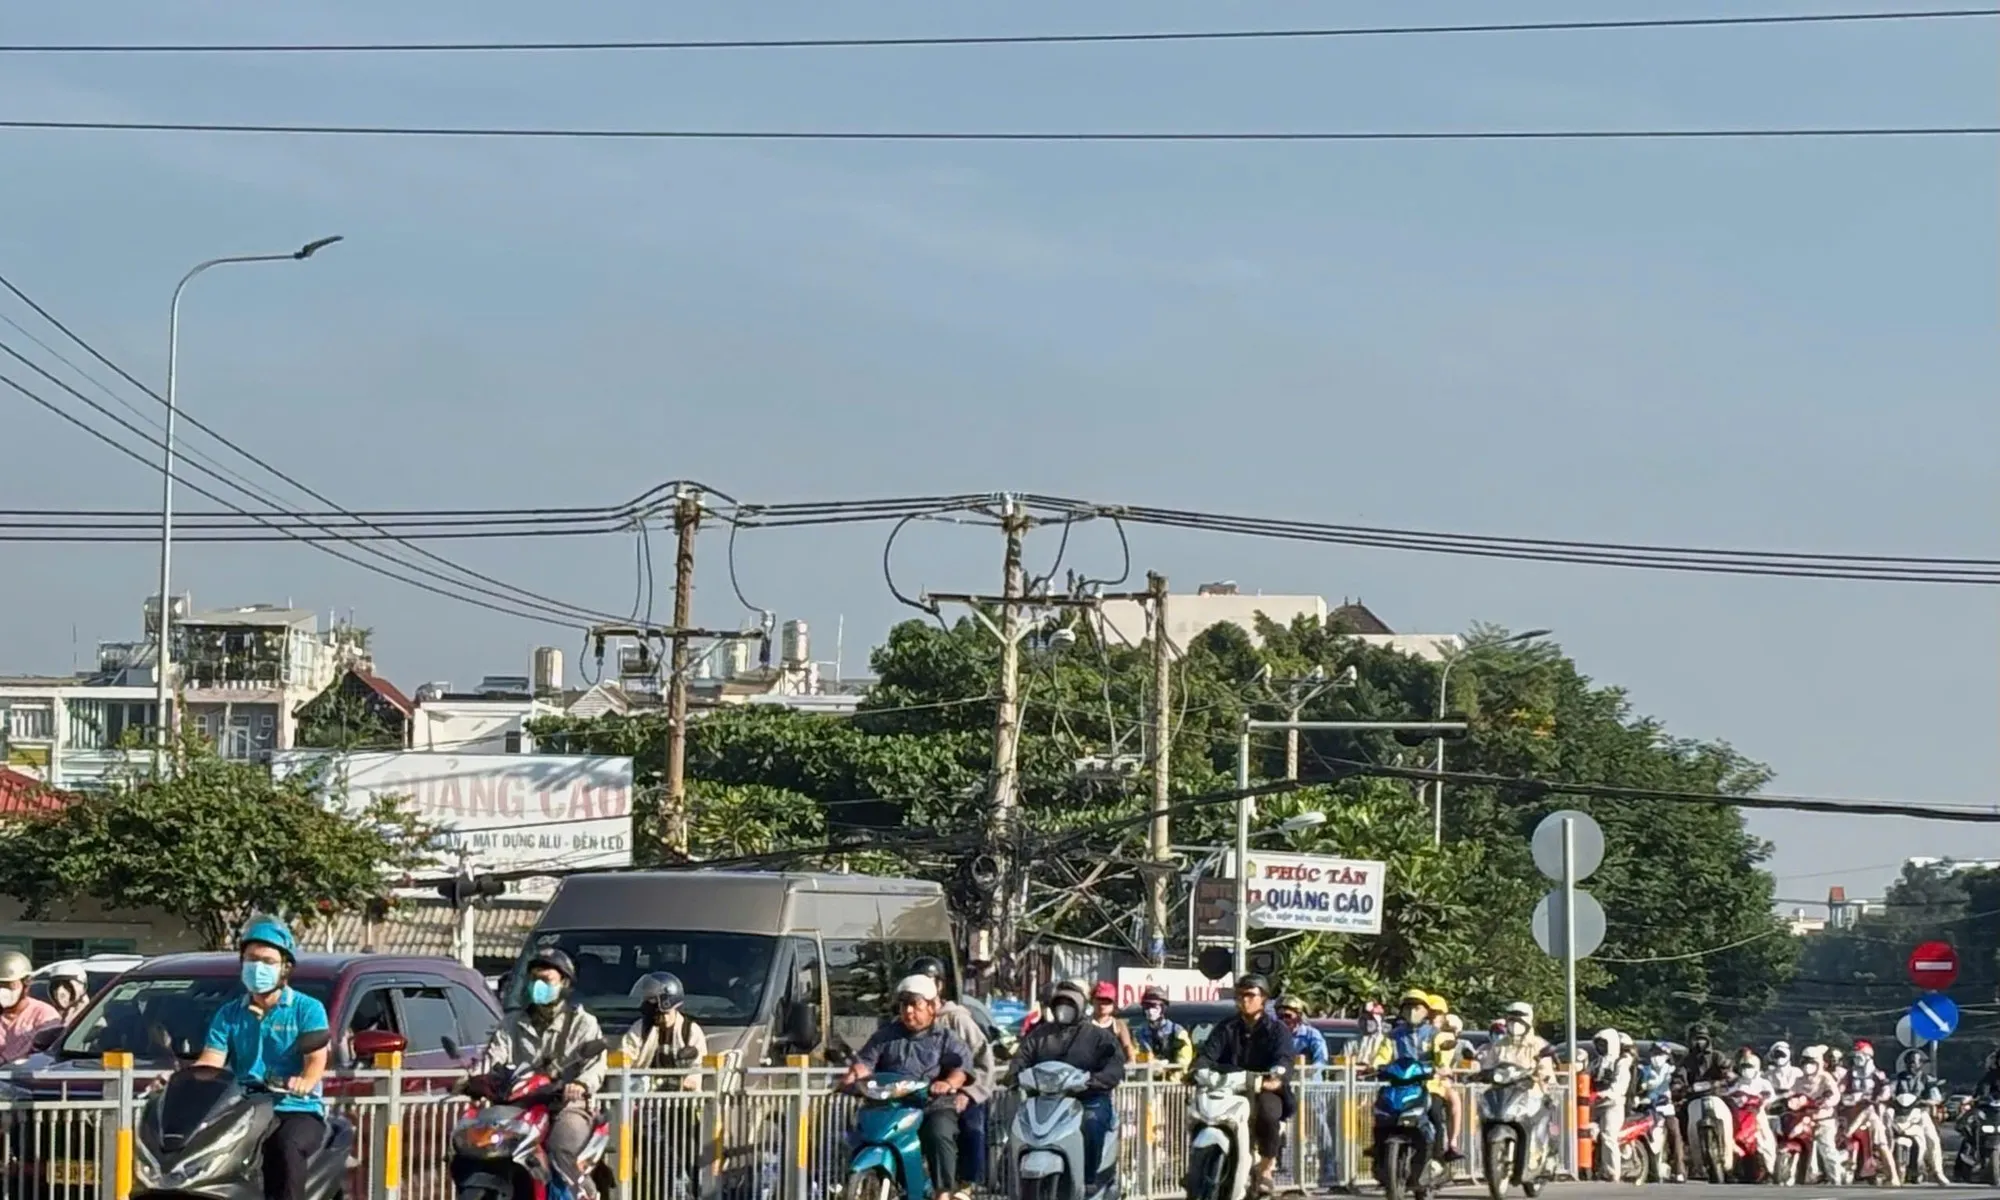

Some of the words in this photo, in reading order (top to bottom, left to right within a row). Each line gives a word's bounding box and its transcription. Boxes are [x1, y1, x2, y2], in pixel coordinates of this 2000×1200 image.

[539, 833, 561, 849] ALU
[601, 836, 624, 850] LED
[1264, 863, 1321, 882] PHÚC
[1325, 866, 1368, 885] TÂN
[1266, 882, 1330, 912] QUẢNG
[1335, 888, 1374, 914] CÁO
